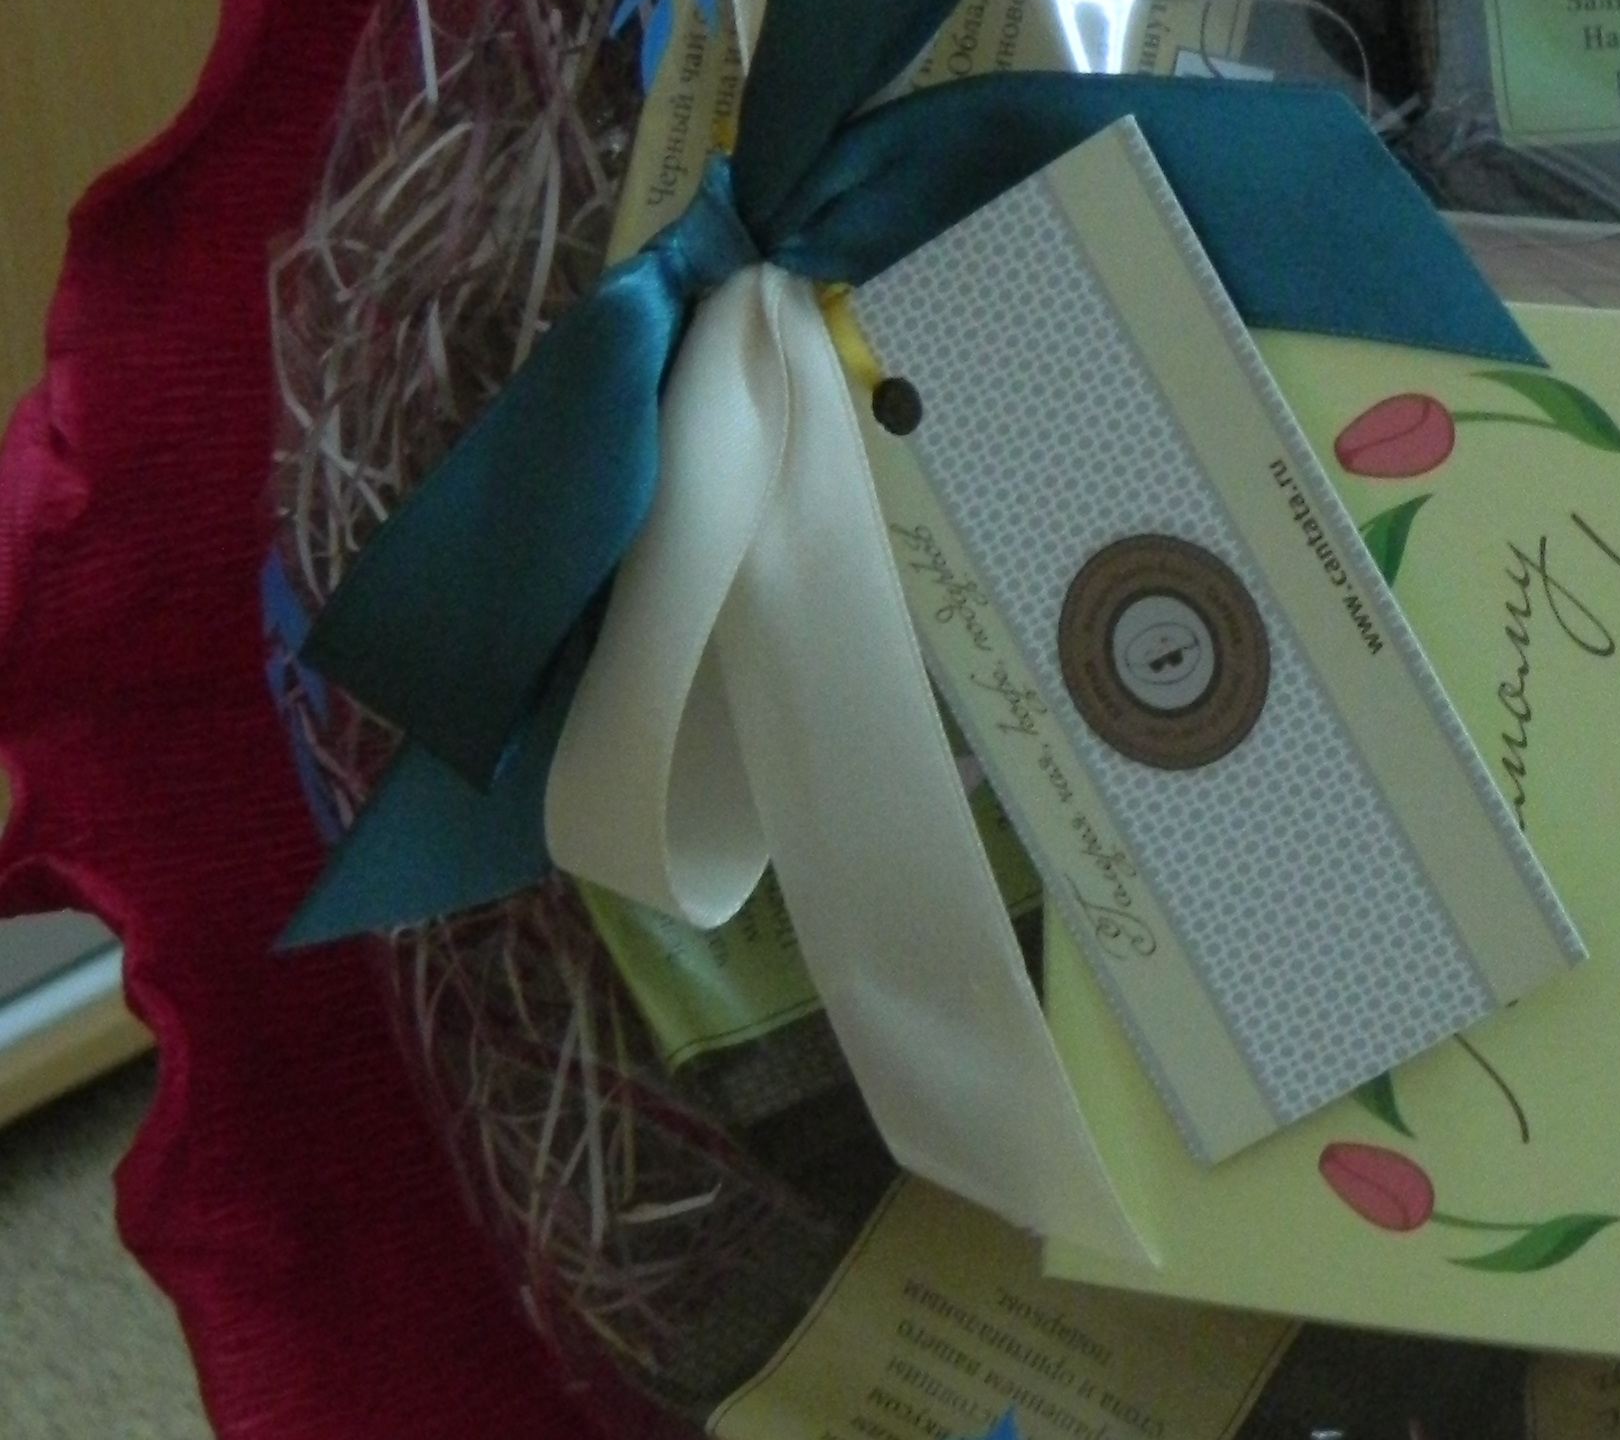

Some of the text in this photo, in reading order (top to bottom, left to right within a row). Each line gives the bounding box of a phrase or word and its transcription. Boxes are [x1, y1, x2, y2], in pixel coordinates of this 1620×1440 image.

[646, 94, 695, 206] Черный
[681, 32, 707, 83] чай
[886, 520, 991, 652] подарков
[1269, 459, 1383, 655] www.cantata.ru
[896, 1319, 981, 1376] вашего
[902, 1279, 1074, 1384] оригинальным
[1099, 1391, 1166, 1440] стола
